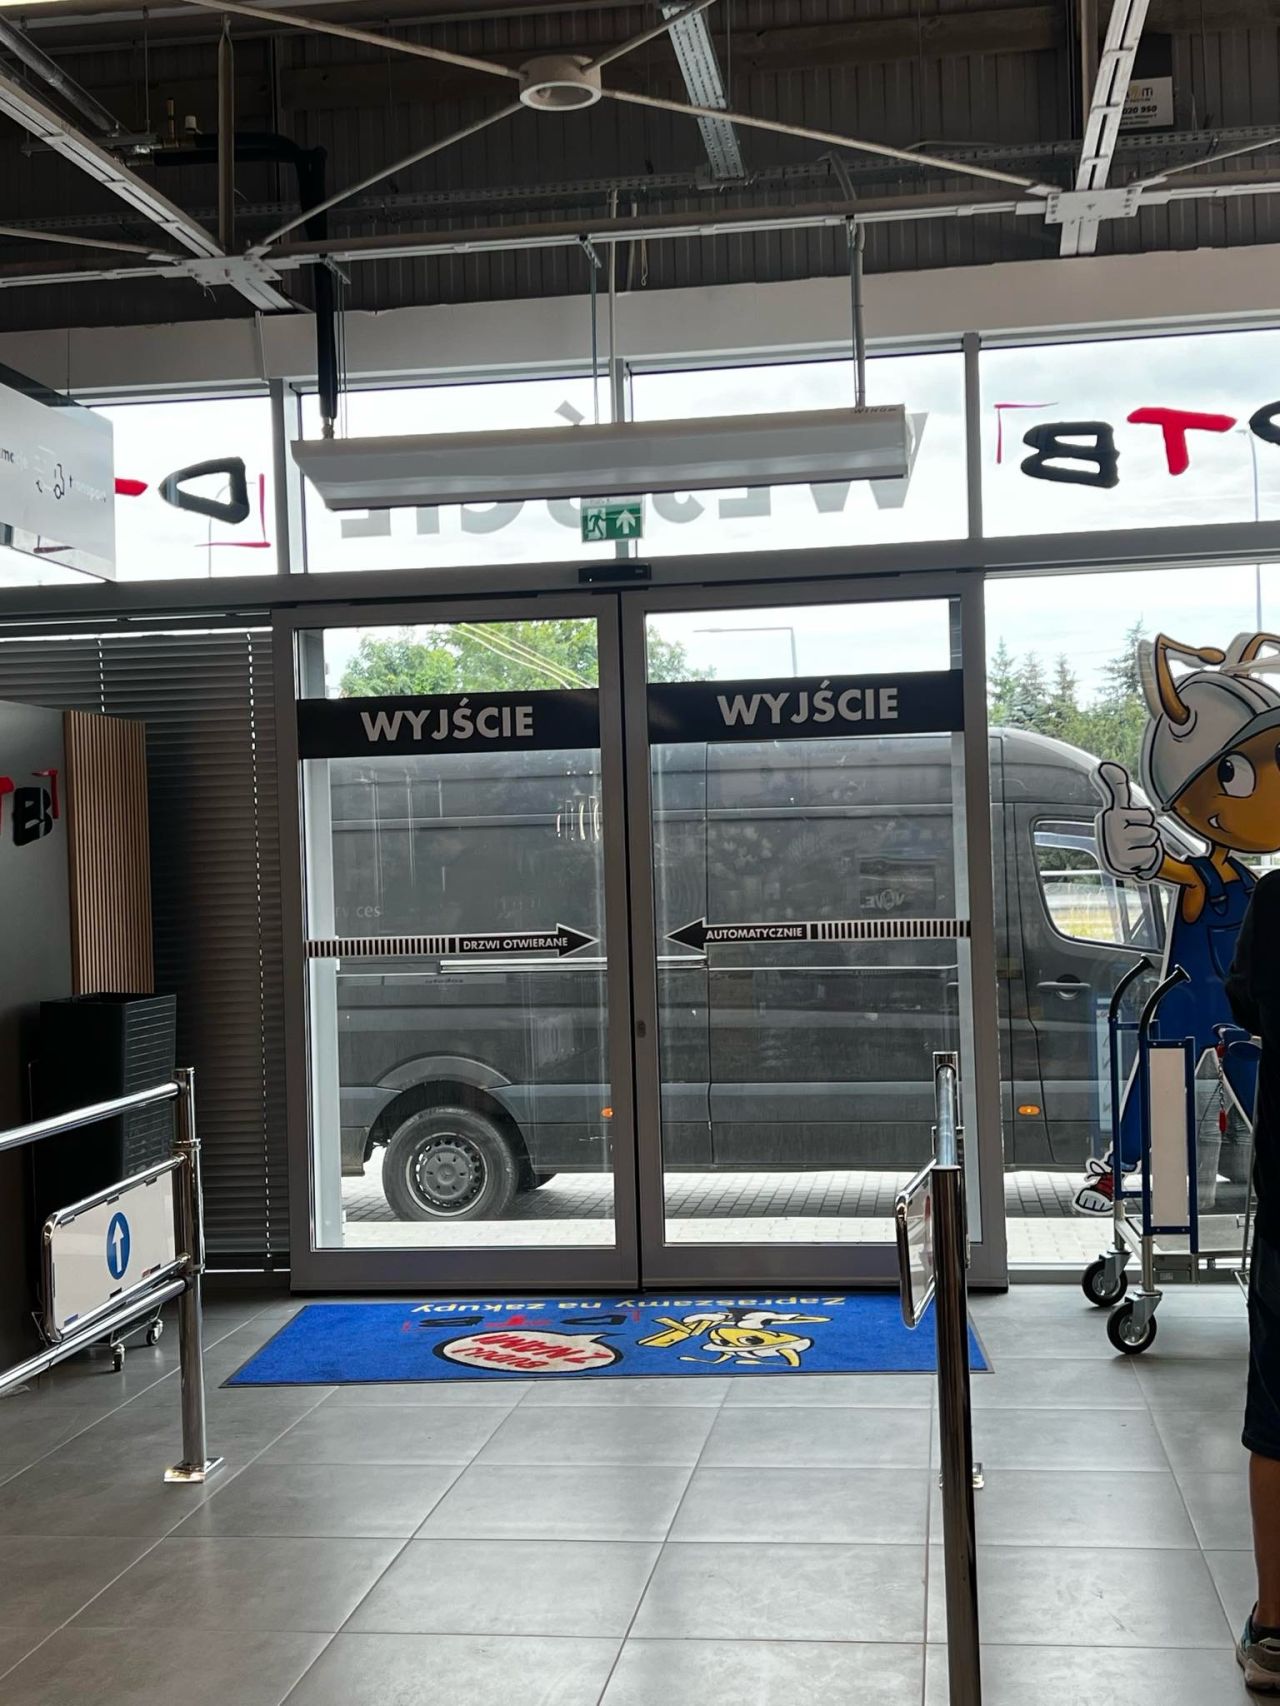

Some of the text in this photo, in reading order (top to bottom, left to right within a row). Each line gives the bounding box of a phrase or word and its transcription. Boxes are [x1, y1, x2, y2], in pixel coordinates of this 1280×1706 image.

[717, 679, 899, 726] WYJŚCIE
[361, 697, 534, 742] WYJŚCIE
[705, 926, 803, 940] AUTOMATYCZNIE
[463, 937, 568, 950] DRZWI OTWIERANE
[410, 1303, 546, 1314] zakupy
[615, 1296, 846, 1308] Zapraszamy
[471, 1334, 585, 1360] NAMI
[451, 1347, 550, 1370] BUDUJ
